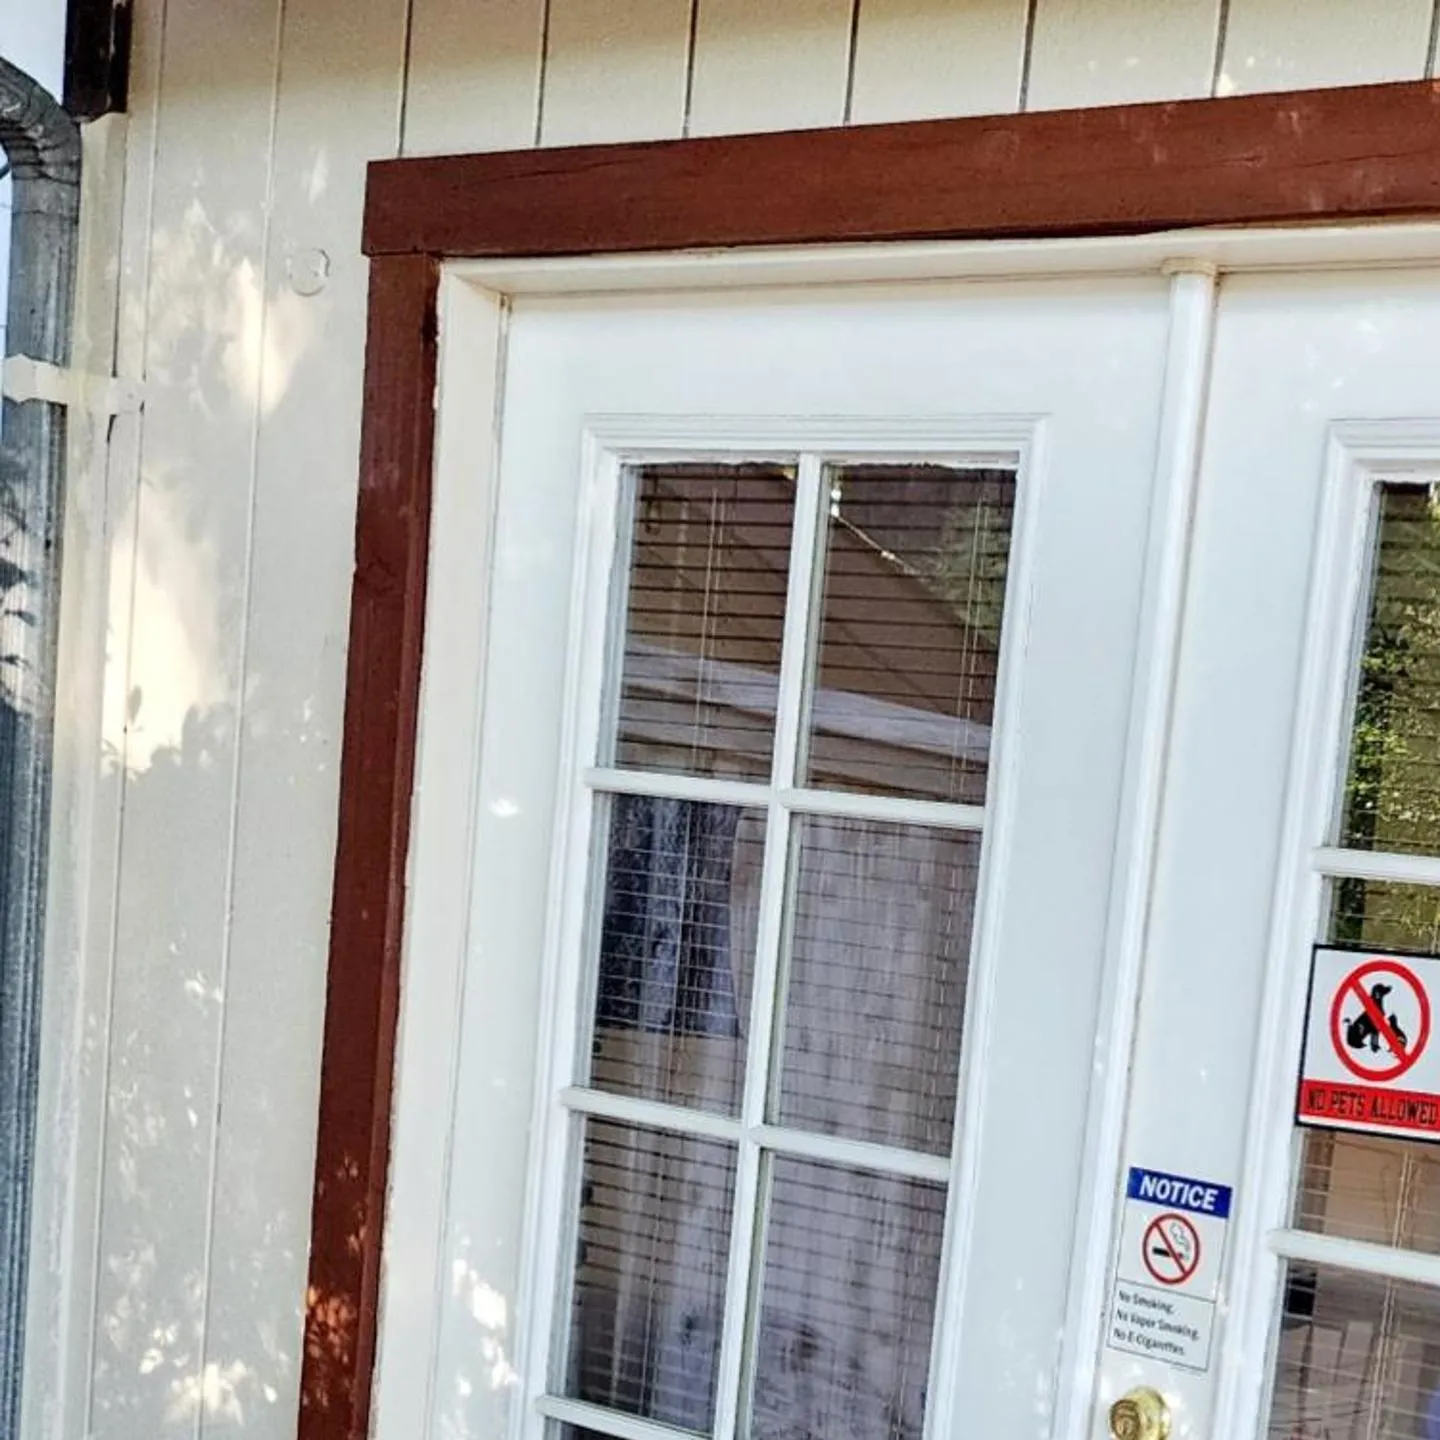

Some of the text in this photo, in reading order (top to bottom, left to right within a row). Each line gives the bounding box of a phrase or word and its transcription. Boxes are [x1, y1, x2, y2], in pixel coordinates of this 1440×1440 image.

[1307, 1087, 1440, 1127] NO PETS ALLOWED
[1139, 1175, 1219, 1211] NOTICE
[1118, 1289, 1132, 1303] No
[1116, 1307, 1129, 1321] No
[1113, 1327, 1127, 1341] No
